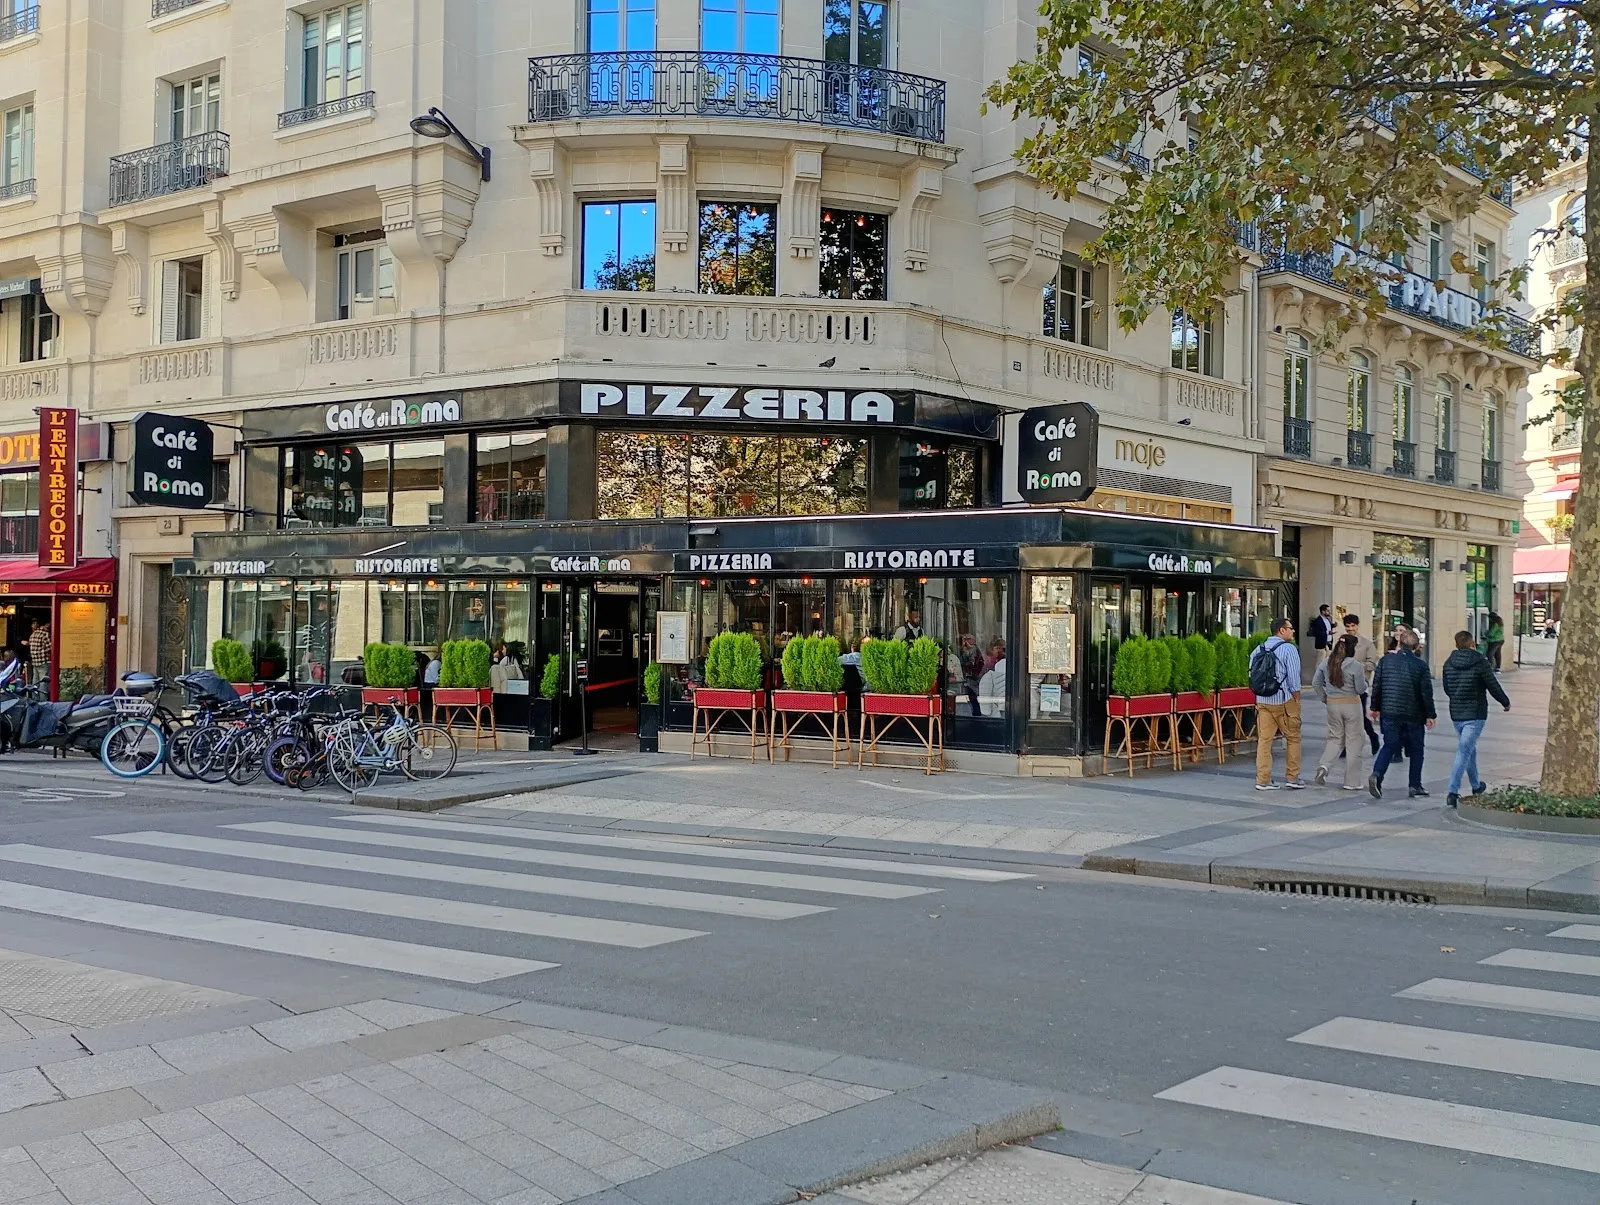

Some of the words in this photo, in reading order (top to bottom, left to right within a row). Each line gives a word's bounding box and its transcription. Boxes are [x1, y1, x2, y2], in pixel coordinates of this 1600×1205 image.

[580, 383, 894, 422] PIZZERIA
[326, 402, 375, 431] Café
[377, 412, 388, 427] di
[391, 399, 460, 425] Roma
[152, 427, 197, 450] Café
[1034, 417, 1077, 441] Café
[167, 455, 182, 470] di
[1048, 446, 1061, 462] di
[1115, 439, 1166, 469] maje
[49, 411, 67, 563] L'ENTRECOTE
[143, 472, 204, 497] Roma
[1026, 470, 1082, 490] Roma
[213, 560, 266, 574] PIZZERIA
[355, 558, 438, 573] RISTORANTE
[550, 556, 581, 571] Café
[590, 556, 631, 571] Roma
[690, 553, 772, 570] PIZZERIA
[844, 549, 975, 568] RISTORANTE
[1148, 553, 1174, 571] Café
[1181, 555, 1212, 573] Roma
[1380, 554, 1396, 565] BNP
[1397, 556, 1430, 568] PARIBAS
[69, 583, 112, 594] GRILL
